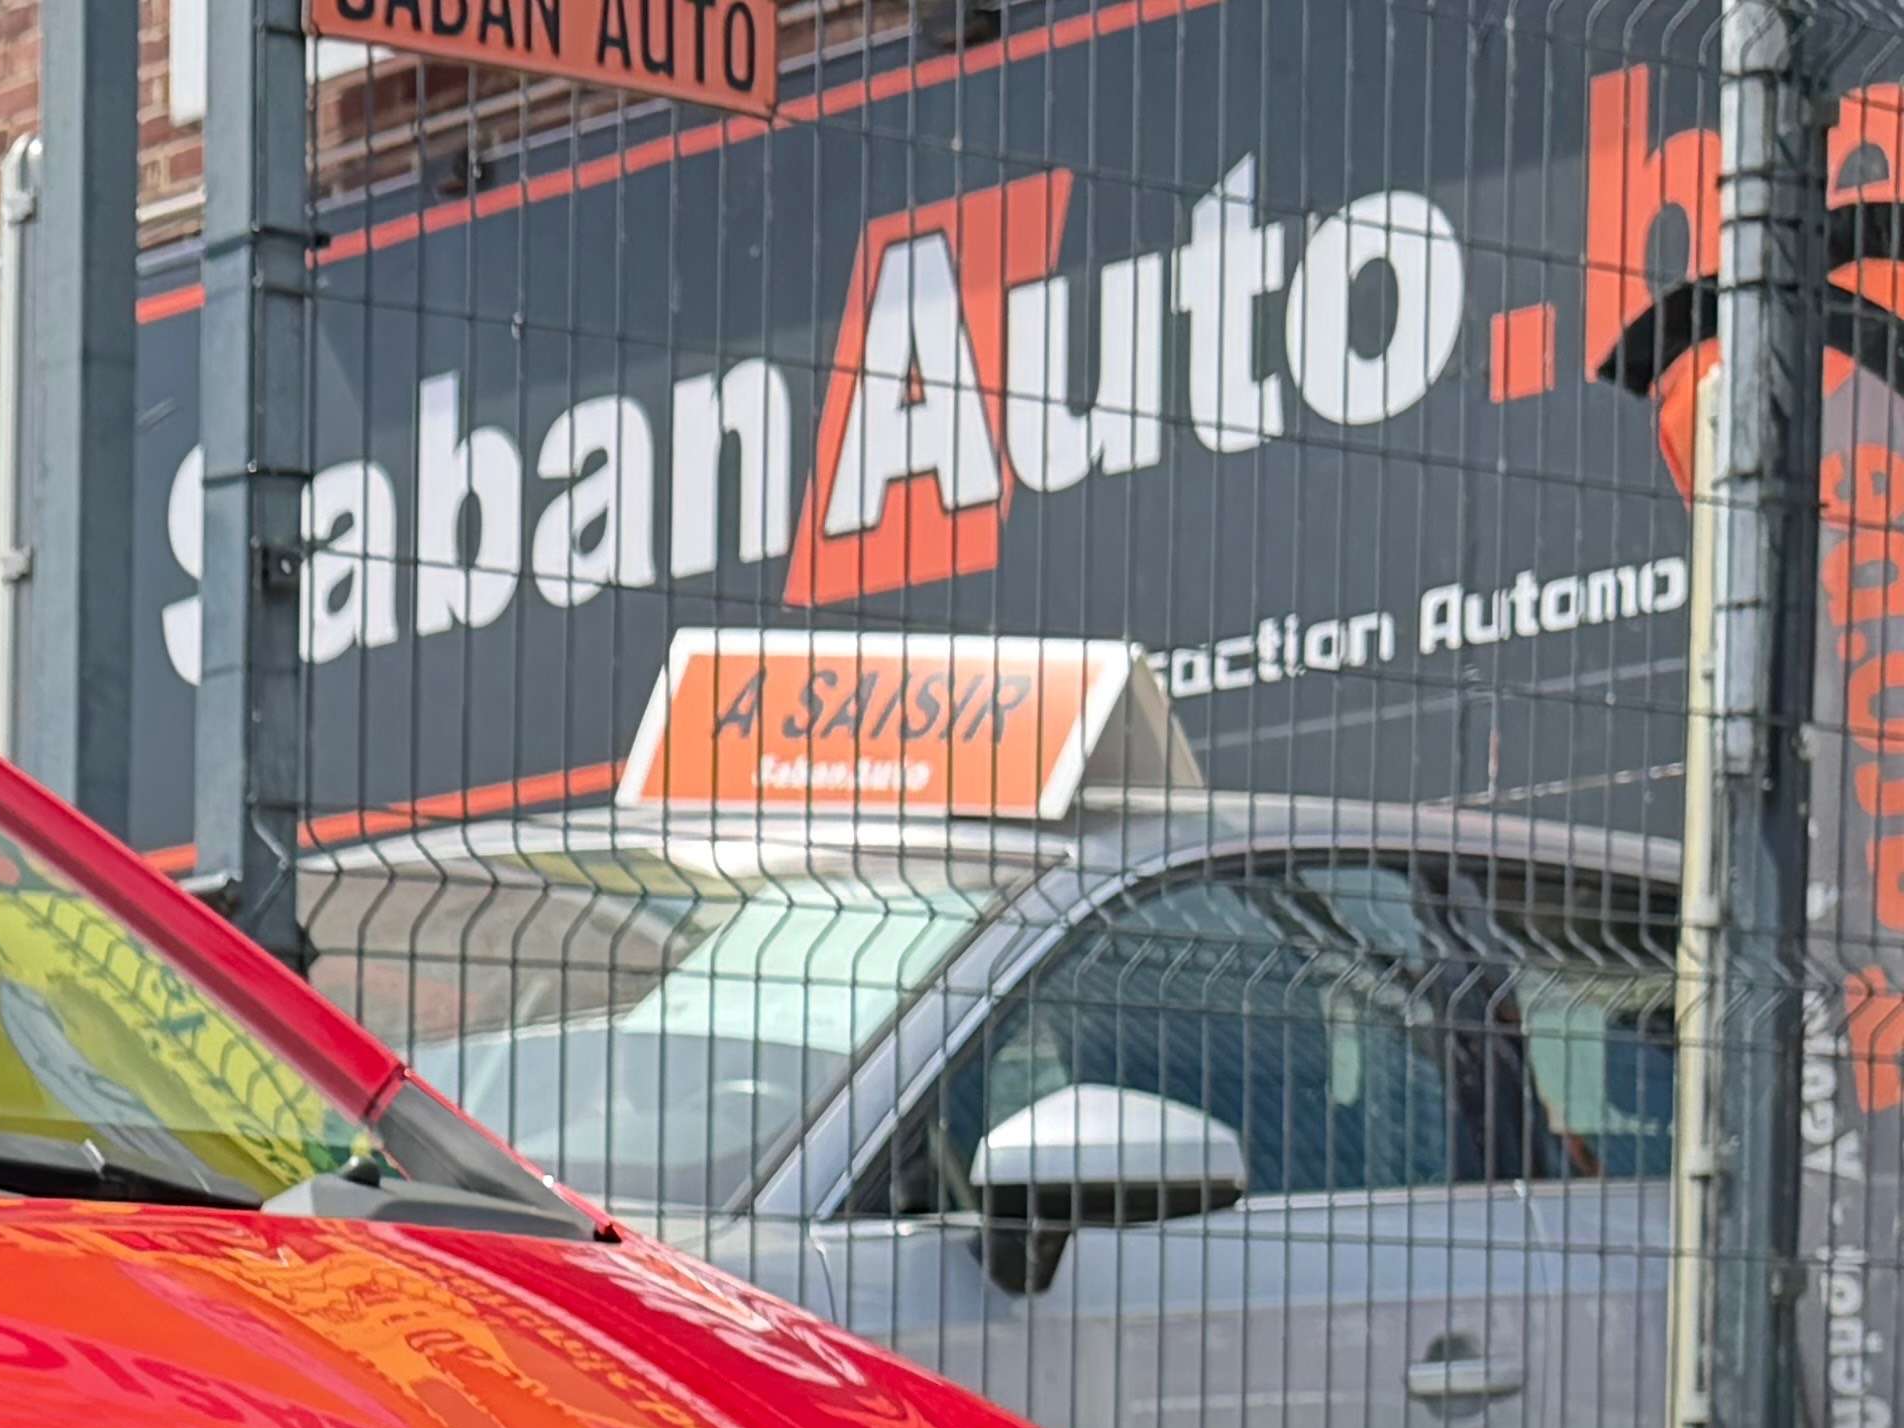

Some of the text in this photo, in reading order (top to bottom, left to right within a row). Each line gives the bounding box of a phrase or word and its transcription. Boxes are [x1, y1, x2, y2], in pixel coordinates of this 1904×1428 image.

[1418, 554, 1690, 656] Automo
[711, 667, 1031, 744] A SAISIR
